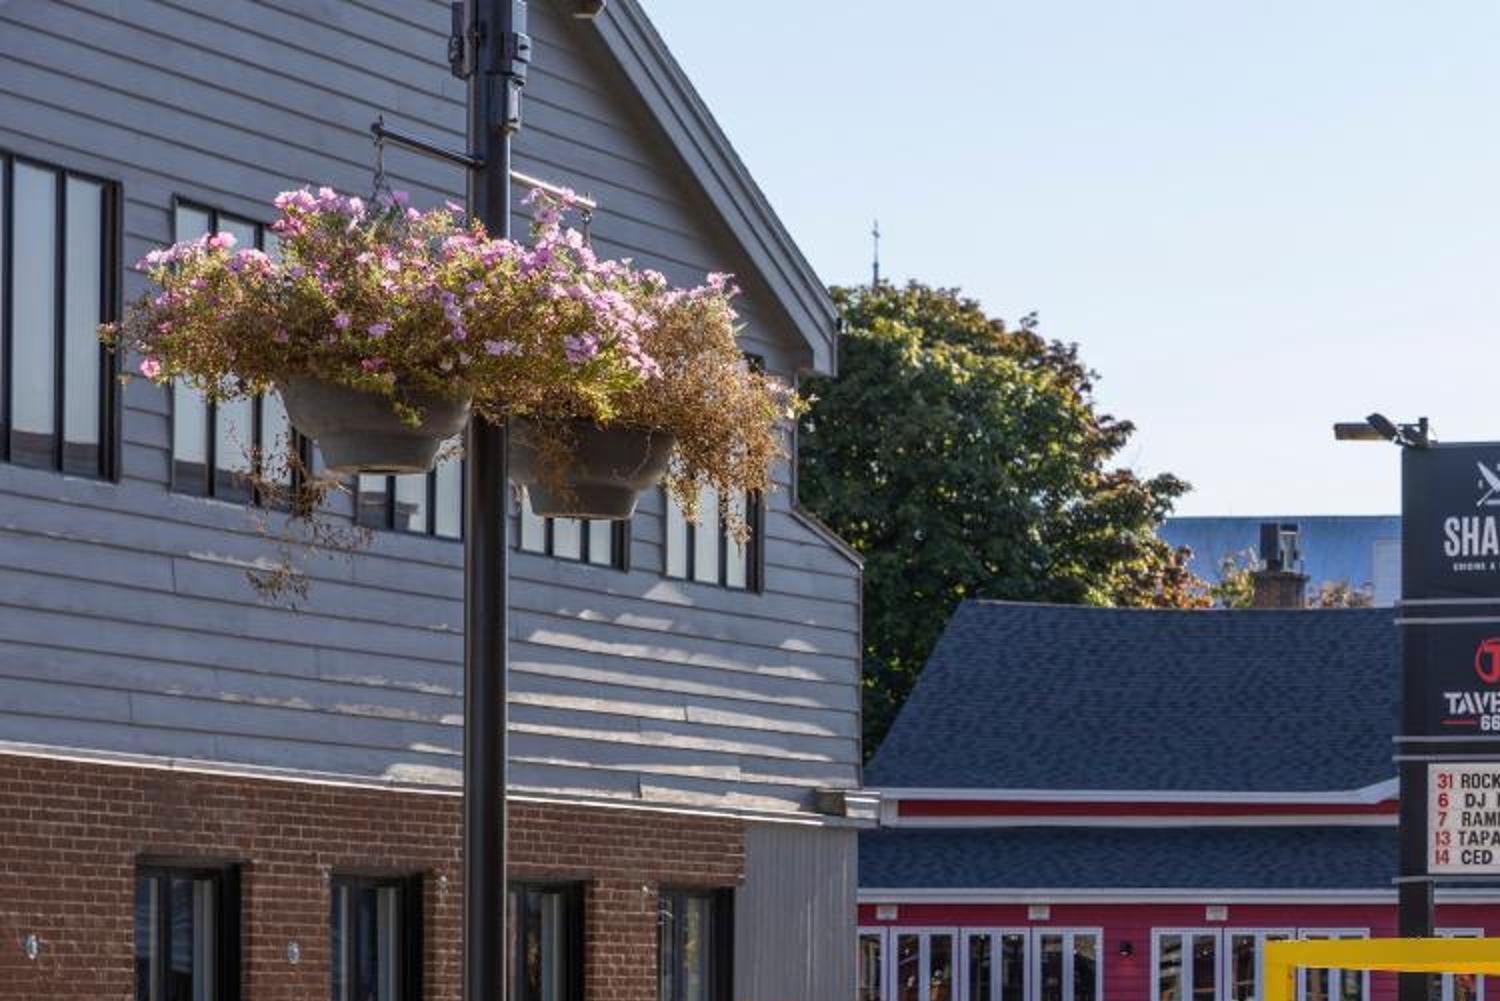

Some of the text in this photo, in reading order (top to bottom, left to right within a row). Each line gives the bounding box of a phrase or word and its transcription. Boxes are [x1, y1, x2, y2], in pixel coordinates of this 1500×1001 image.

[1437, 773, 1453, 789] 31
[1438, 793, 1449, 808] 6
[1465, 793, 1486, 808] DJ
[1438, 812, 1447, 827] 7
[1435, 831, 1451, 846] 13
[1435, 850, 1450, 865] 14
[1461, 849, 1493, 865] CED
